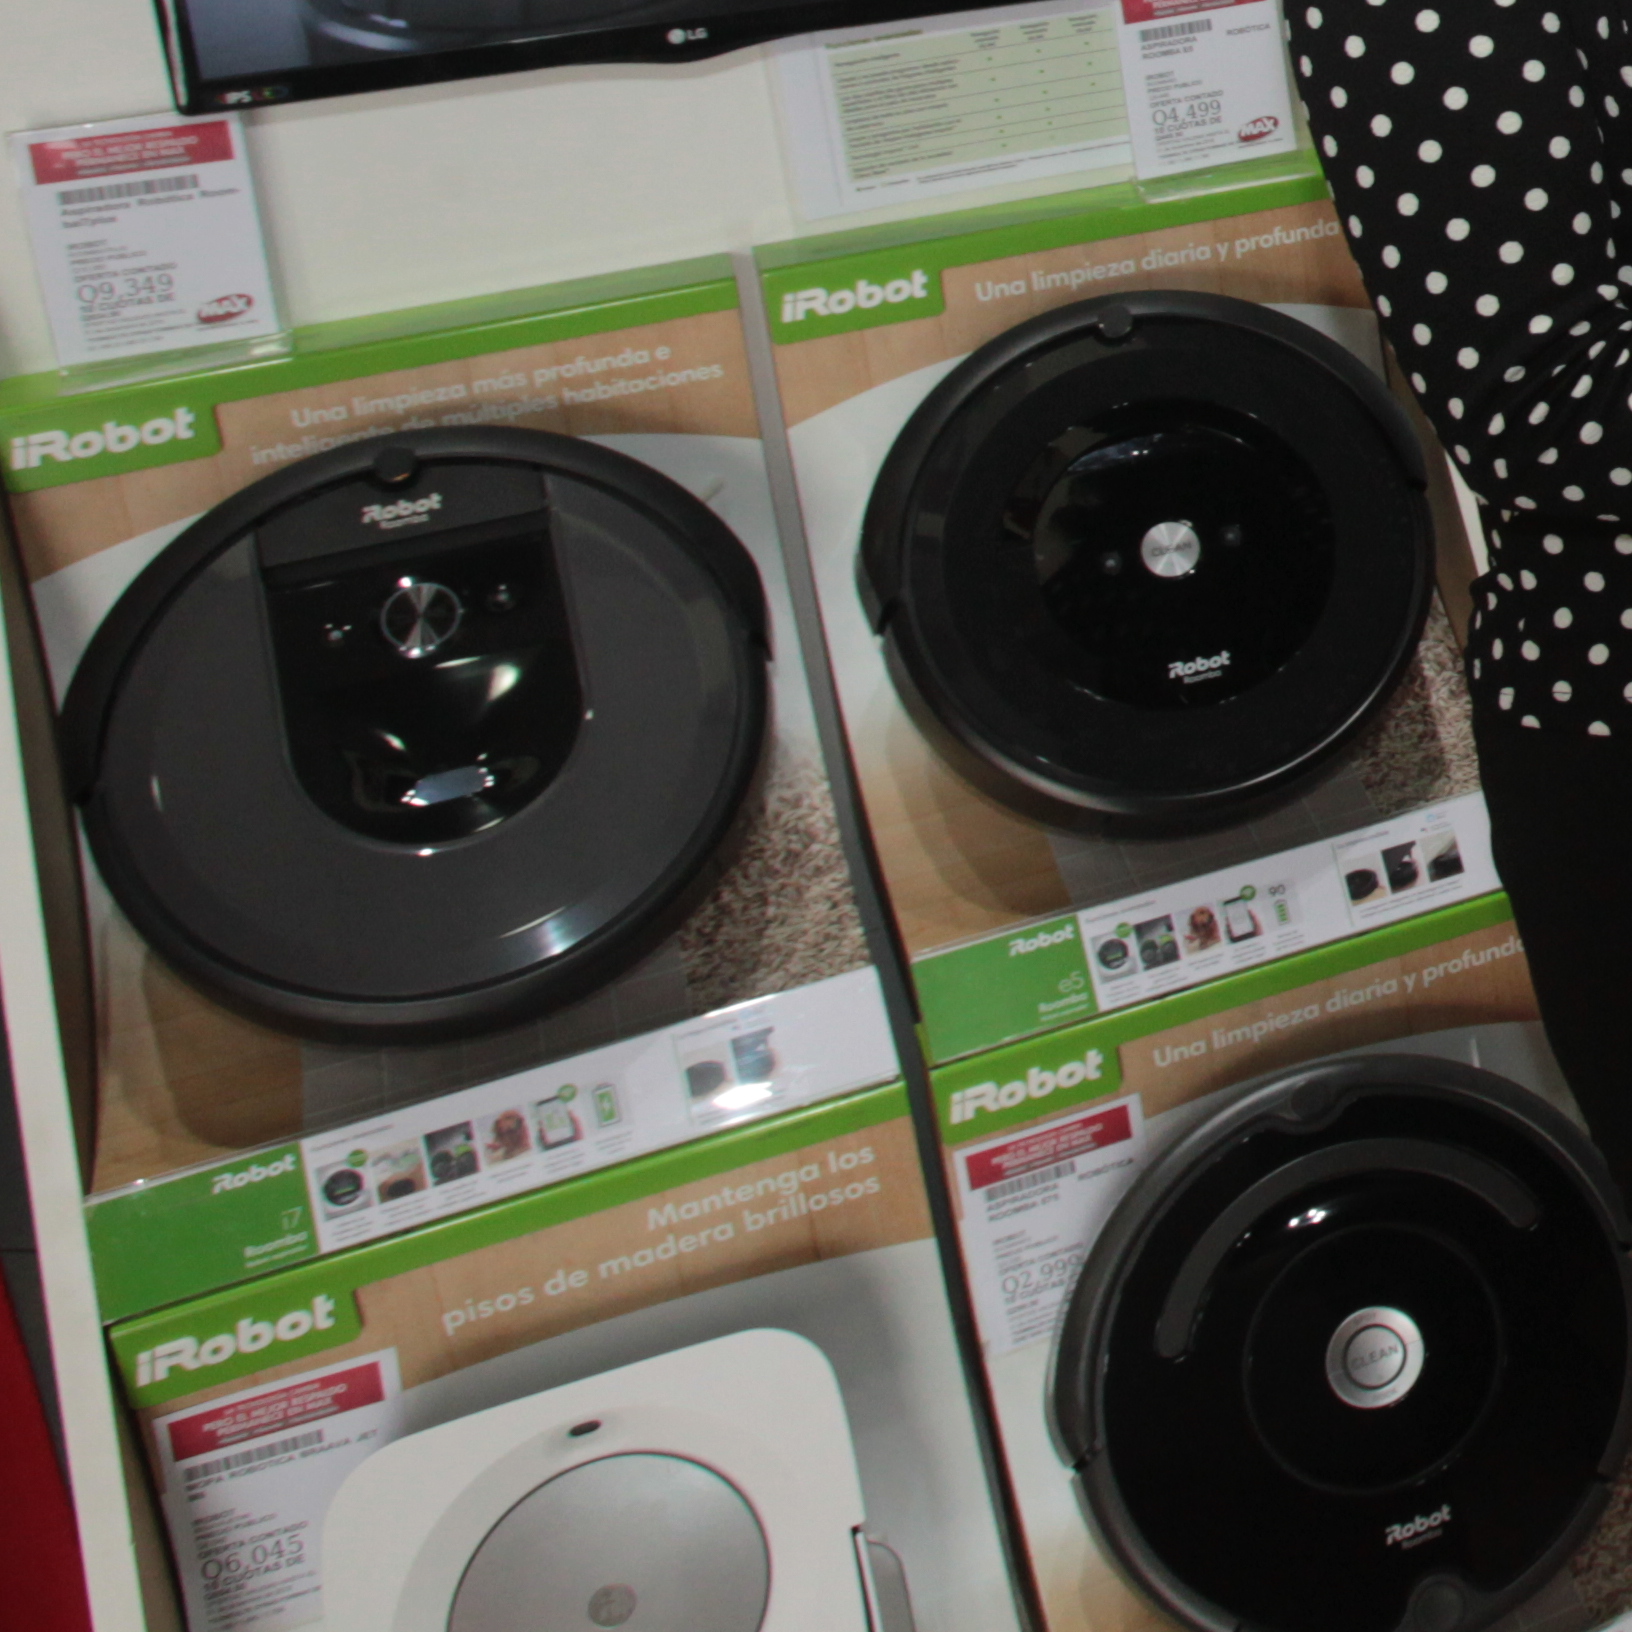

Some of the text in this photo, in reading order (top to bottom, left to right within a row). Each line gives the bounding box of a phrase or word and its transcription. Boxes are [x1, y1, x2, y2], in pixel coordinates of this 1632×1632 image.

[1152, 98, 1222, 126] Q4,499
[1243, 116, 1279, 138] MAX
[779, 217, 1341, 324] iRobot Una limpieza diaria y profunda
[290, 403, 349, 429] Una
[472, 369, 528, 397] más
[533, 346, 650, 389] profunda
[654, 343, 672, 362] e
[563, 359, 725, 407] habitaciones
[9, 407, 196, 468] iRobot
[1150, 541, 1193, 558] CLEAN
[1058, 970, 1085, 995] e5
[950, 1048, 1104, 1126] iRobot
[1152, 1036, 1206, 1068] Una
[1211, 1000, 1321, 1053] limpieza
[1324, 977, 1399, 1012] diaria
[1403, 973, 1417, 994] y
[134, 1293, 336, 1388] iRobot
[645, 1161, 821, 1233] Mantenga
[826, 1143, 876, 1180] los
[439, 1173, 882, 1336] pisos de madera brillosos
[1351, 1344, 1400, 1366] CLEAN
